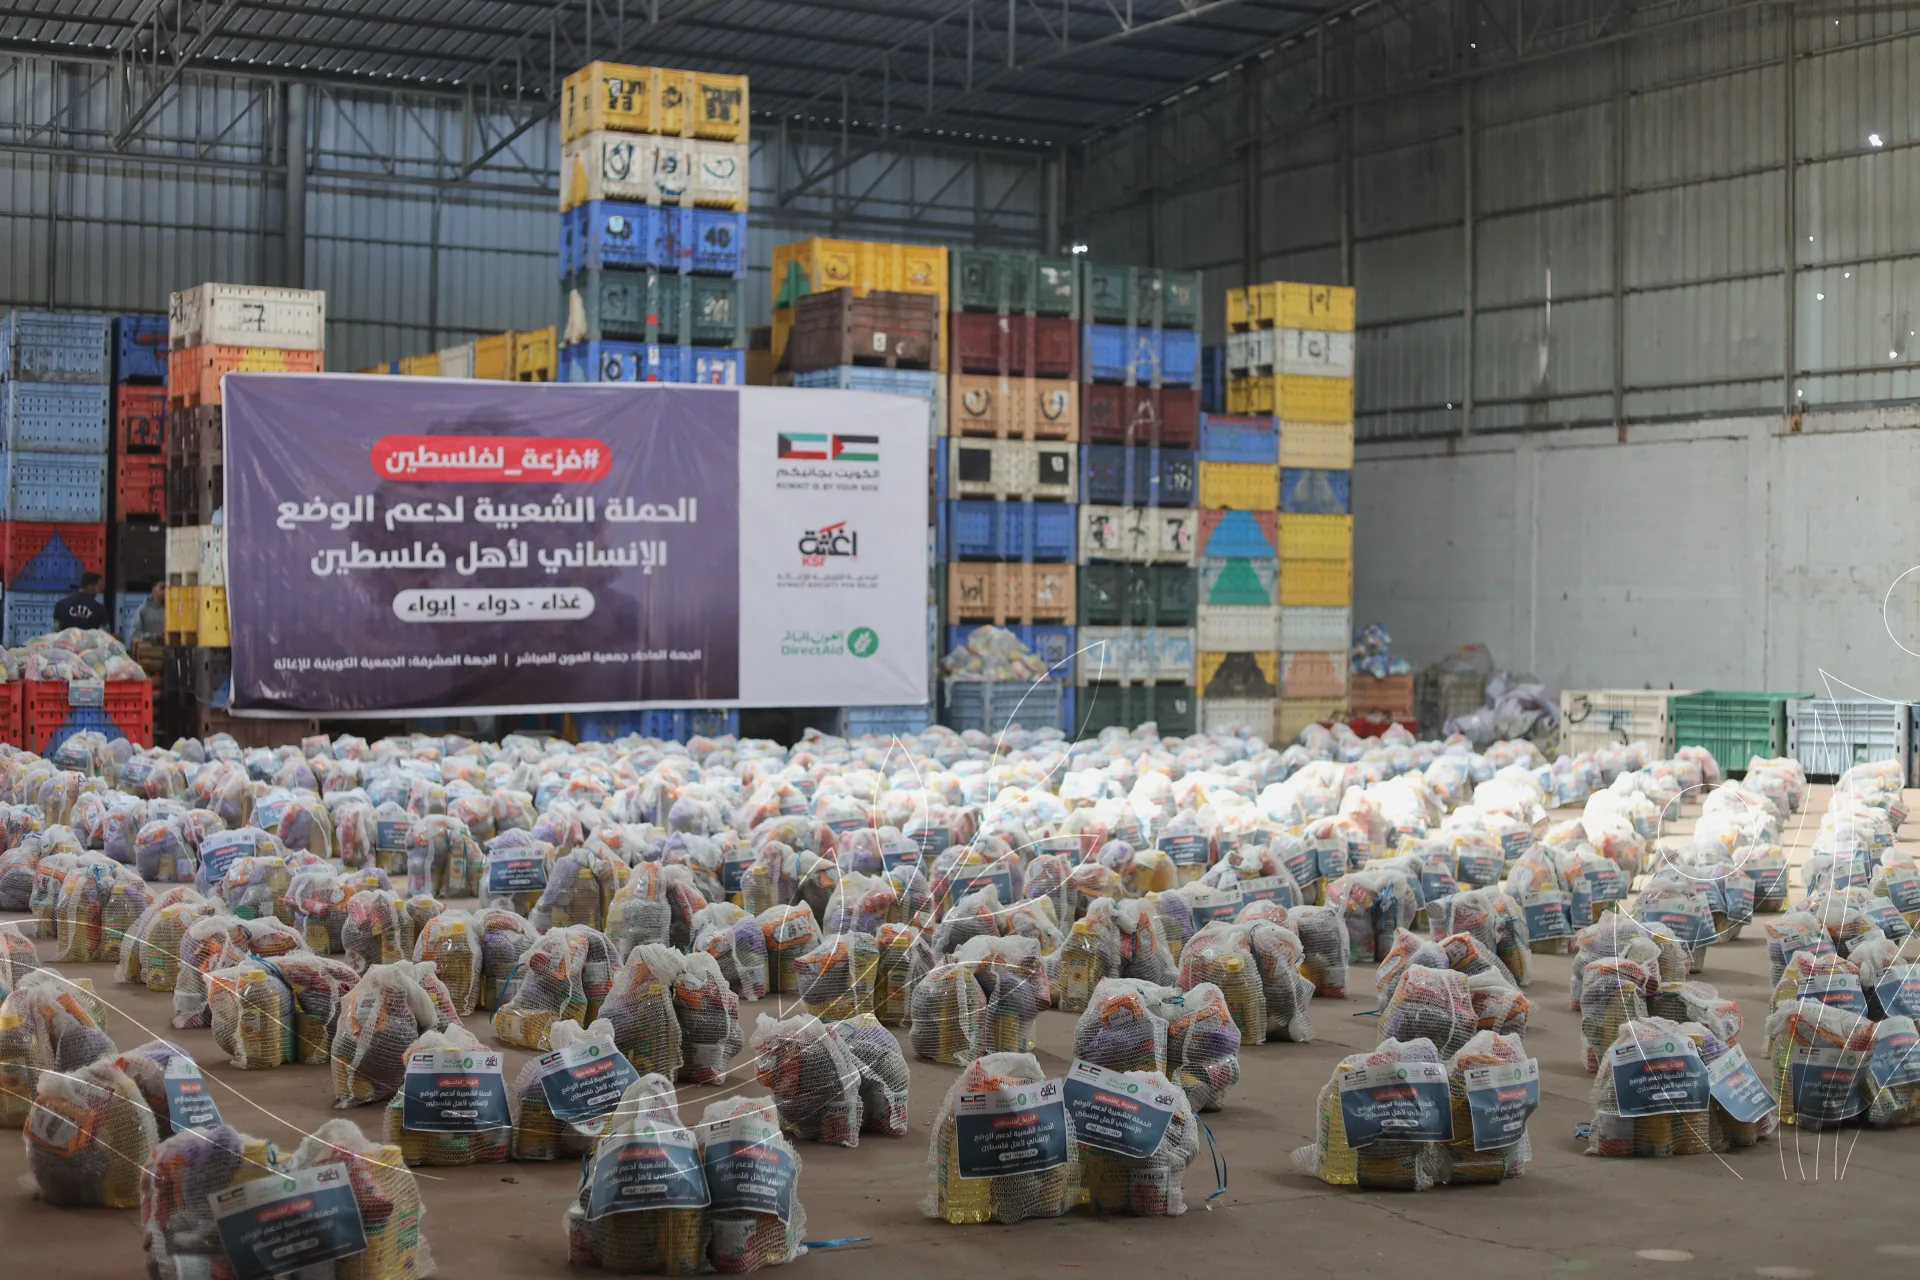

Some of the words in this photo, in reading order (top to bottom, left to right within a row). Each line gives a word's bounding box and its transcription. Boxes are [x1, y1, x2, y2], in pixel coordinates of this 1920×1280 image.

[386, 445, 600, 477] #فزعة_لفلسطين
[276, 495, 374, 529] الوضع
[386, 496, 464, 531] لدعم
[474, 493, 594, 528] الشعبية
[605, 497, 697, 523] الحملة
[310, 540, 445, 576] فلسطين
[457, 538, 527, 575] لأهل
[538, 540, 666, 574] الإنساني
[407, 595, 456, 618] إيواء
[476, 595, 521, 615] دواء
[541, 593, 582, 611] غذاء
